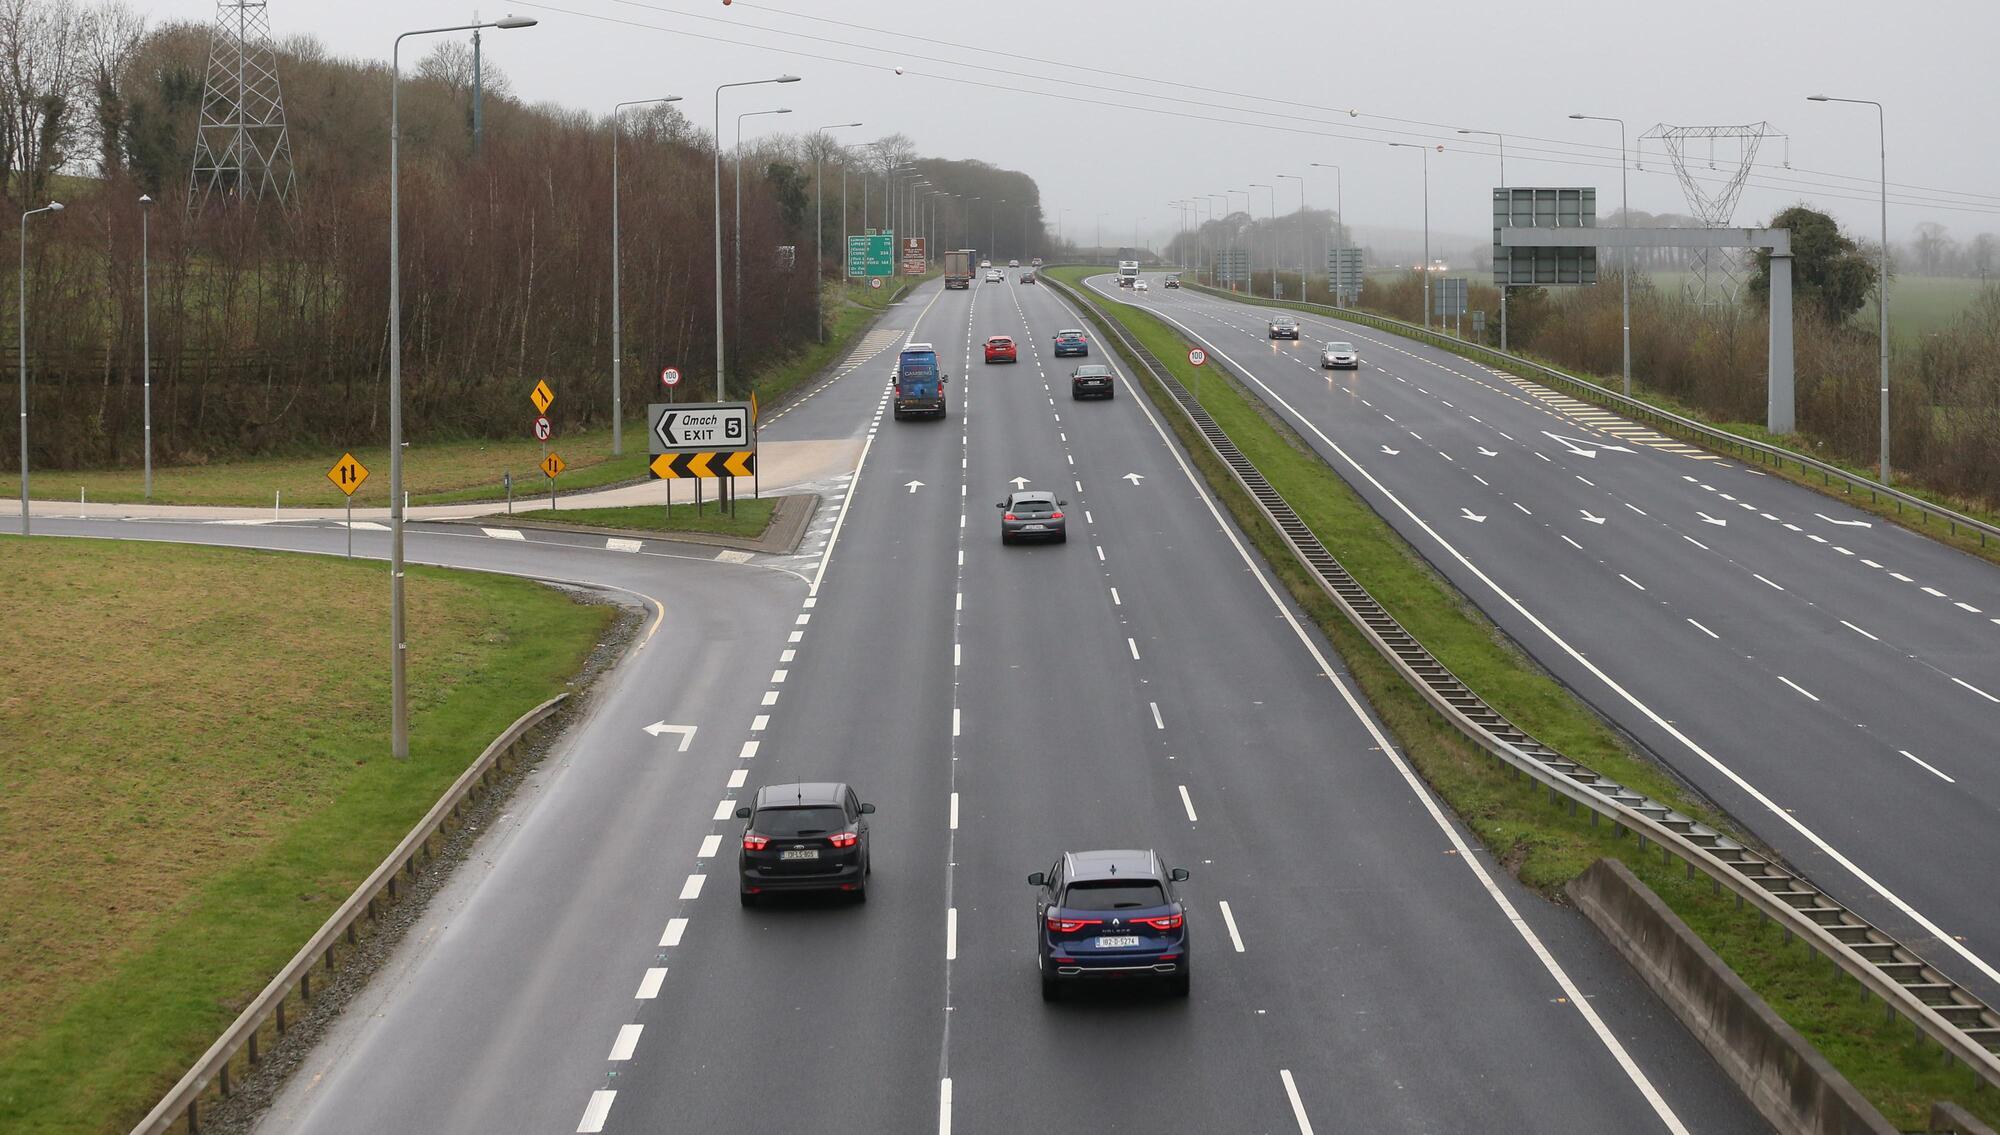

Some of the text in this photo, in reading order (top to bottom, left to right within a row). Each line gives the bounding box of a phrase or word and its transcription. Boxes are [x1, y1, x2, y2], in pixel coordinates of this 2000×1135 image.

[1192, 351, 1203, 359] 100
[665, 371, 677, 379] 100
[727, 420, 739, 436] 5
[684, 429, 714, 440] EXIT
